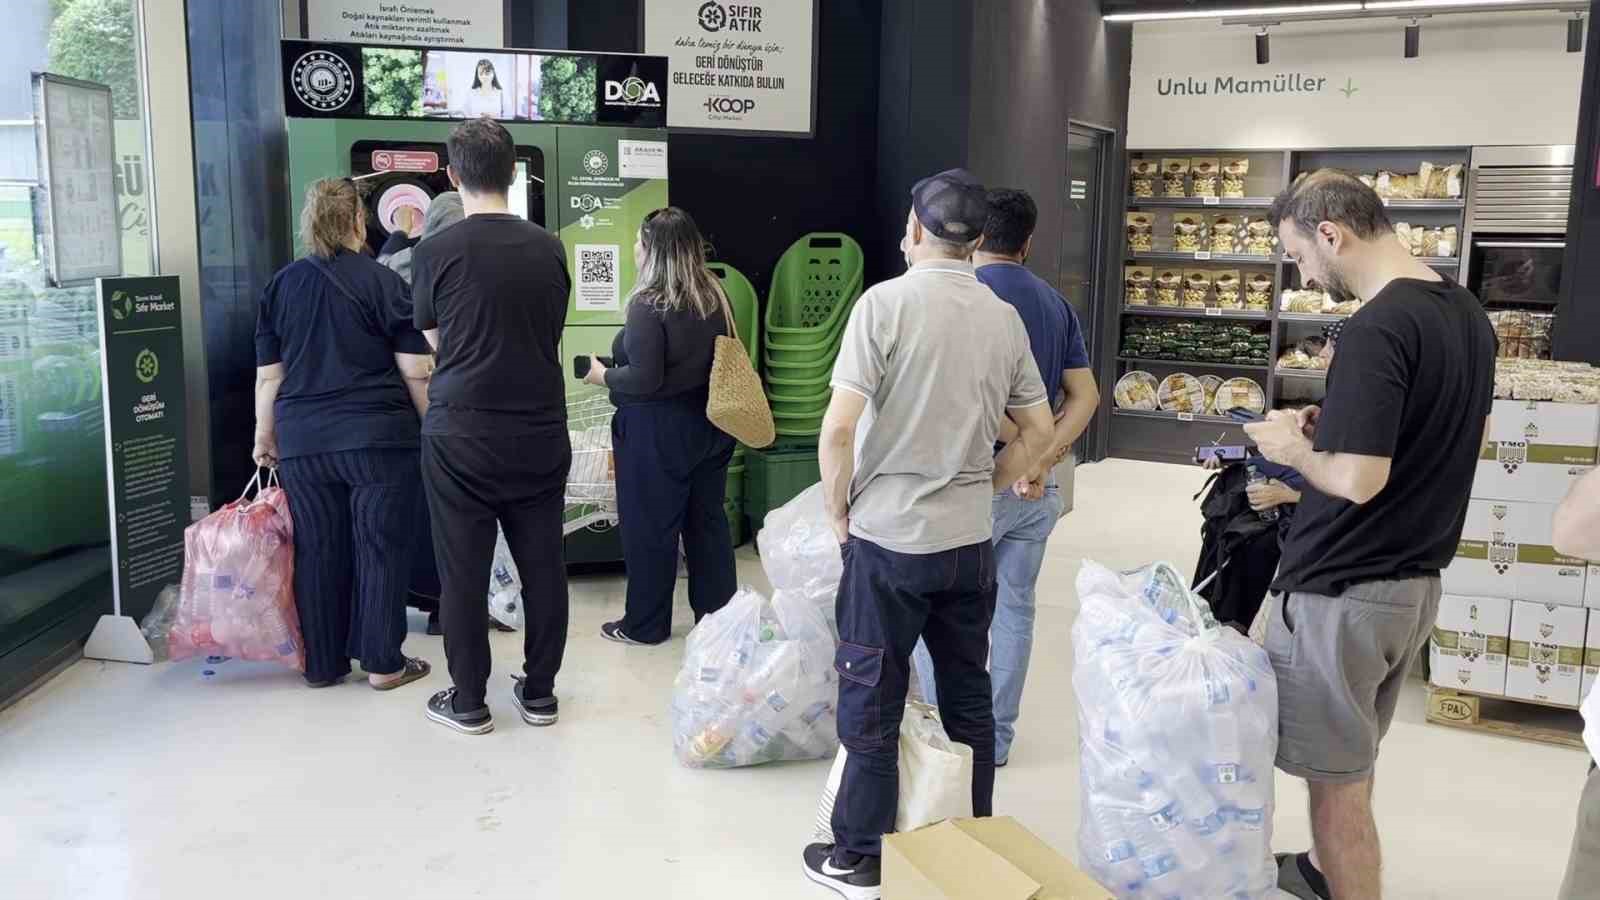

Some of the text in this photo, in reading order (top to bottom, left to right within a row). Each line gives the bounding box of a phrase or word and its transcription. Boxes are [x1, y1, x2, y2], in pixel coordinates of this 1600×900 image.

[728, 5, 762, 18] SIFIR
[729, 18, 762, 32] ATIK
[717, 55, 763, 72] DÖNÜŞTÜR
[673, 71, 785, 90] GELECEĞE KATKIDA BULUN
[1157, 73, 1327, 96] Unlu Mamüller
[1500, 440, 1526, 448] TMO
